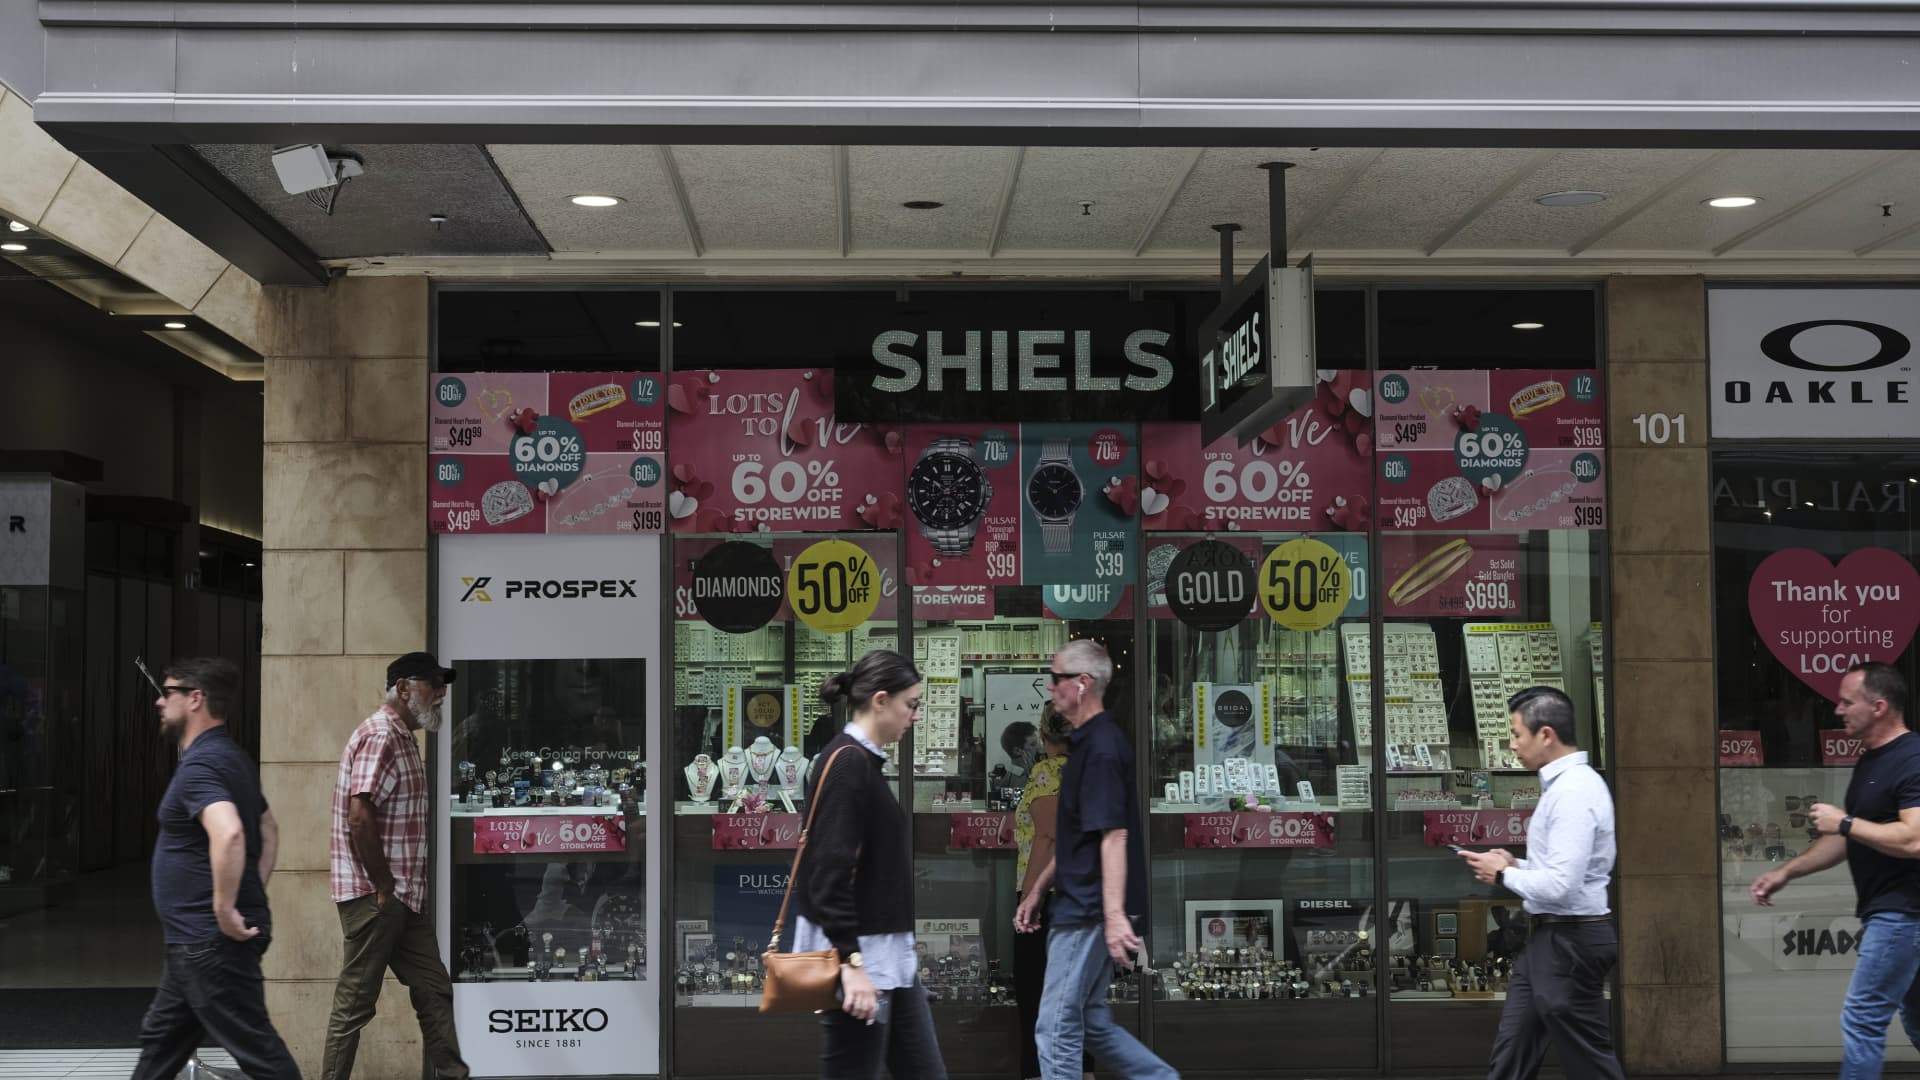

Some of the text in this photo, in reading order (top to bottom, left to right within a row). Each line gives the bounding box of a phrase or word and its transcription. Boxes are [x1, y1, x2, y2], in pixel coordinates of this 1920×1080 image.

[1223, 311, 1260, 390] SHIELS
[871, 329, 1174, 392] SHIELS
[638, 378, 653, 397] 1/2
[1577, 376, 1591, 394] 1/2
[709, 393, 784, 415] LOTS
[434, 417, 452, 425] Diamond
[453, 417, 464, 425] Heart
[616, 420, 661, 428] Diamond Love Pendant
[742, 417, 778, 436] TO
[1557, 417, 1600, 425] Diamond Love Pendant
[1633, 413, 1686, 444] 101
[633, 429, 661, 451] $199
[1459, 432, 1524, 458] 60% OFF
[1573, 426, 1602, 447] $199
[514, 436, 581, 462] 60% OFF
[984, 441, 1008, 461] 70% OFF
[1096, 441, 1120, 460] 70% OFF
[732, 454, 761, 462] UP TO
[1460, 458, 1522, 468] DIAMONDS
[516, 463, 579, 472] DIAMONDS
[732, 460, 843, 504] 60% OFF
[1203, 460, 1313, 503] 60% OFF
[433, 500, 450, 508] Diamond
[633, 510, 661, 531] $199
[734, 505, 841, 521] STOREWIDE
[984, 516, 1017, 525] PULSAR
[1204, 506, 1311, 520] STOREWIDE
[1575, 505, 1602, 527] $199
[10, 515, 26, 533] R
[1093, 531, 1125, 539] PULSAR
[985, 541, 999, 552] RRP
[1094, 540, 1108, 551] RRP
[986, 552, 1015, 580] $99
[1095, 550, 1123, 579] $39
[1500, 560, 1515, 569] Solid
[1269, 557, 1340, 612] 50%
[1319, 588, 1339, 603] OFF
[1479, 570, 1515, 582] Gold Bangles
[506, 579, 637, 599] PROSPEX
[695, 576, 782, 598] DIAMONDS
[798, 556, 870, 614] 50%
[849, 588, 869, 603] OFF
[1178, 570, 1244, 605] GOLD
[1771, 579, 1900, 606] Thank you
[914, 594, 986, 604] TOREWIDE
[1465, 580, 1508, 612] $699
[1509, 600, 1516, 609] EA
[1821, 604, 1851, 624] for
[1780, 626, 1894, 649] supporting
[539, 747, 581, 763] Going
[585, 746, 640, 760] Forward
[1721, 740, 1757, 755] 50%
[1825, 739, 1867, 756] 50%
[490, 821, 523, 831] LOTS
[728, 817, 761, 827] LOTS
[967, 817, 1000, 827] LOTS
[1200, 817, 1232, 826] LOTS
[1269, 818, 1314, 837] 60%
[1440, 814, 1472, 824] LOTS
[504, 832, 519, 840] TO
[560, 822, 606, 842] 60%
[742, 828, 759, 837] TO
[980, 827, 997, 836] TO
[1215, 826, 1232, 836] TO
[1453, 824, 1469, 833] TO
[739, 874, 798, 888] PULSA
[758, 889, 787, 897] WATCHE
[1300, 900, 1352, 909] DIESEL
[932, 922, 969, 932] LORUS
[488, 1007, 608, 1033] SEIKO
[516, 1039, 582, 1048] SINCE 1881
